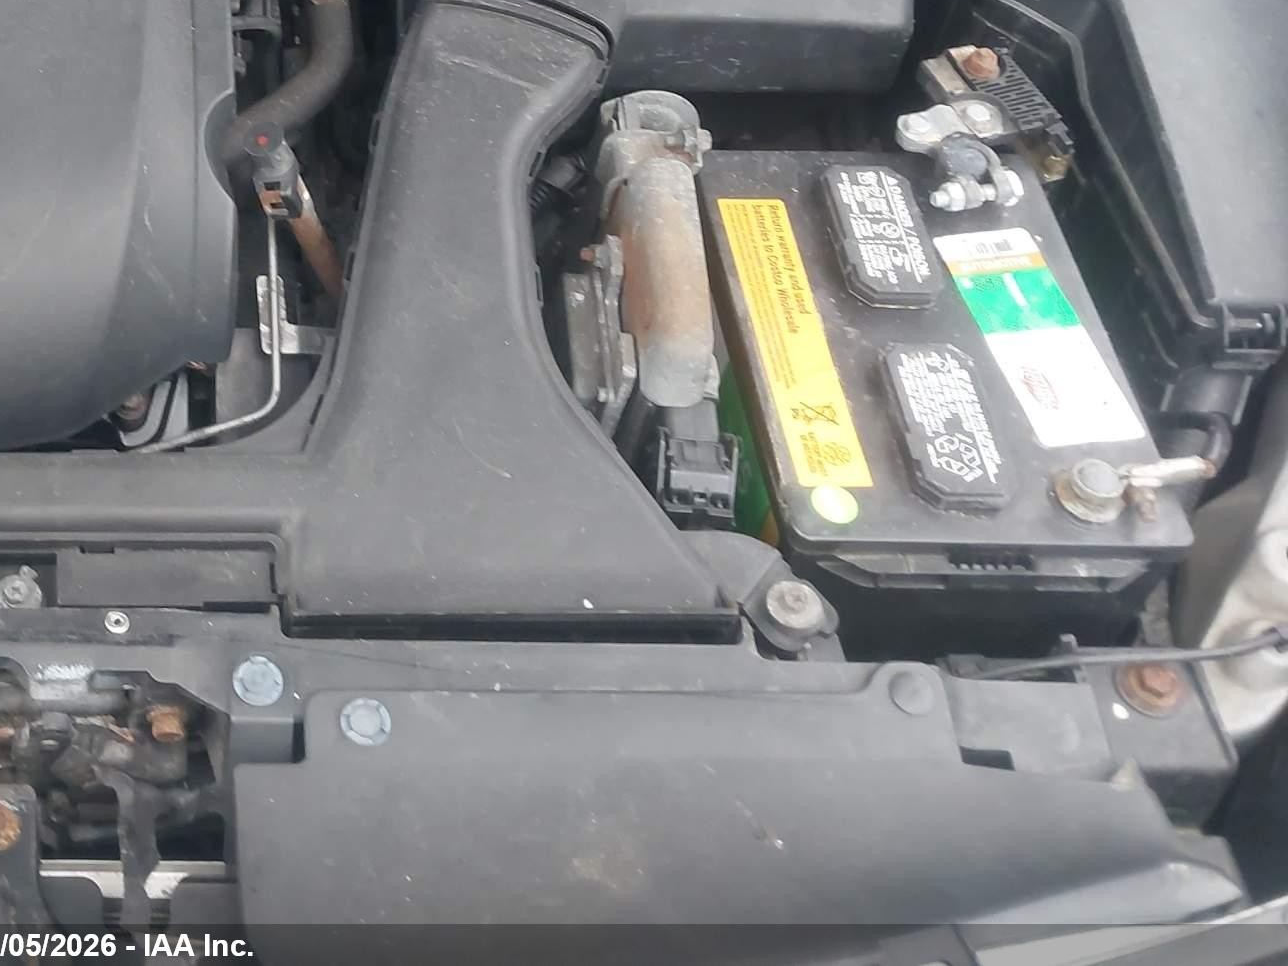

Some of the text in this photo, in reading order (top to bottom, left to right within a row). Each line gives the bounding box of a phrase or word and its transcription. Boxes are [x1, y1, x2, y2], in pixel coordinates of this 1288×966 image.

[752, 204, 770, 242] batteries
[767, 255, 783, 286] Costco
[776, 288, 800, 333] Wholesale
[768, 204, 812, 314] Return warranty and used
[906, 236, 931, 275] POISON
